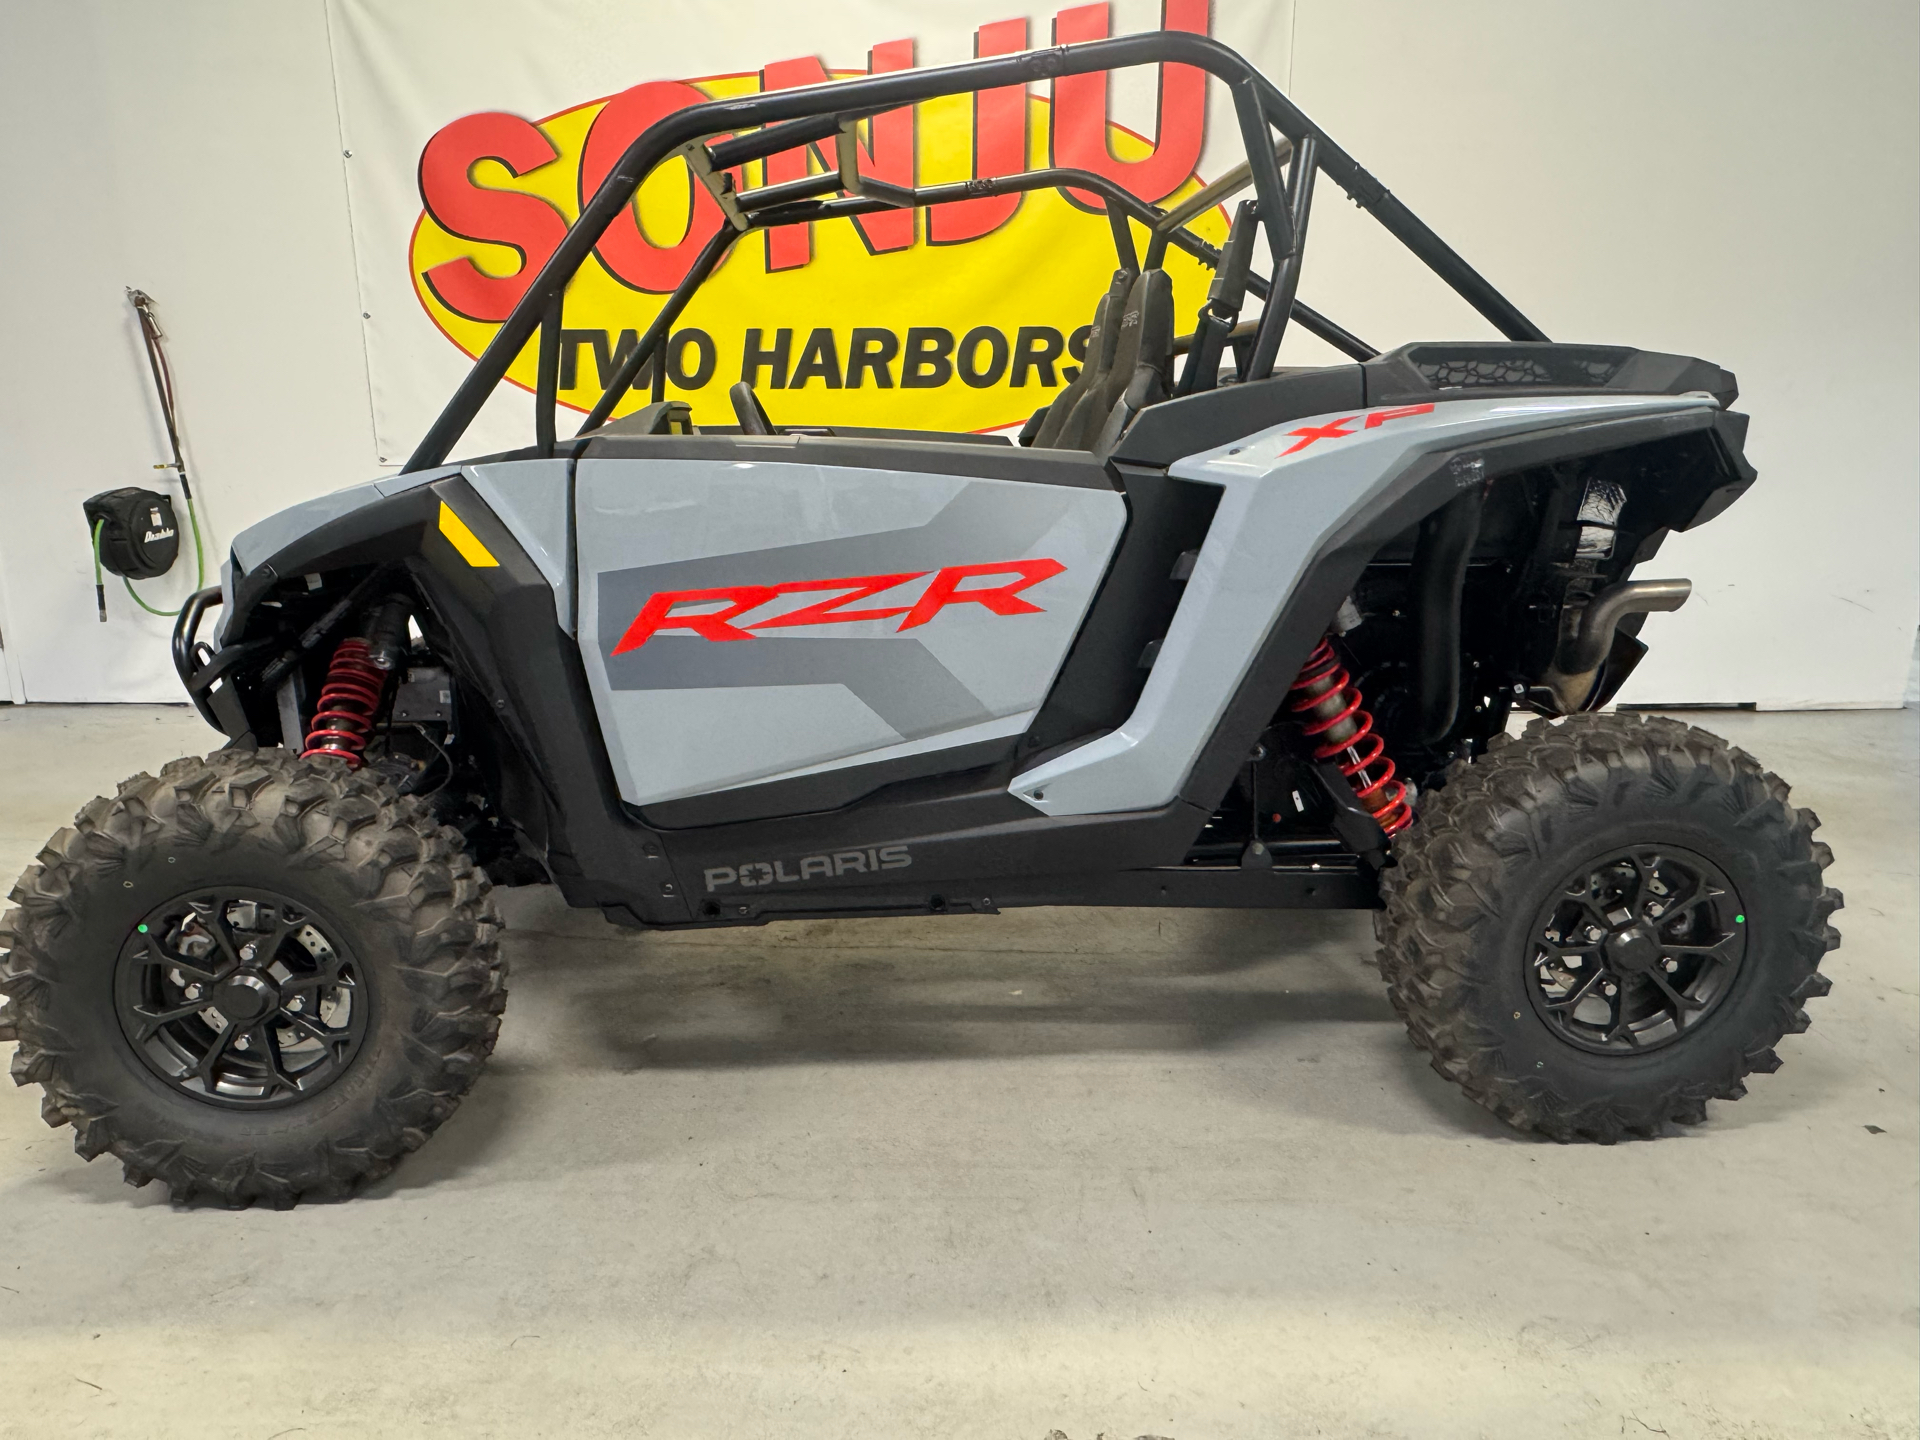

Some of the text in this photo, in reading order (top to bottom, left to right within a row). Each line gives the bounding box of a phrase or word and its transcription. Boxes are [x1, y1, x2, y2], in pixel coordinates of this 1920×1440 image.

[418, 0, 1209, 321] SONJU
[560, 328, 717, 391] TWO
[1274, 403, 1436, 459] XP
[610, 558, 1068, 657] RZR
[704, 845, 912, 892] POLARIS
